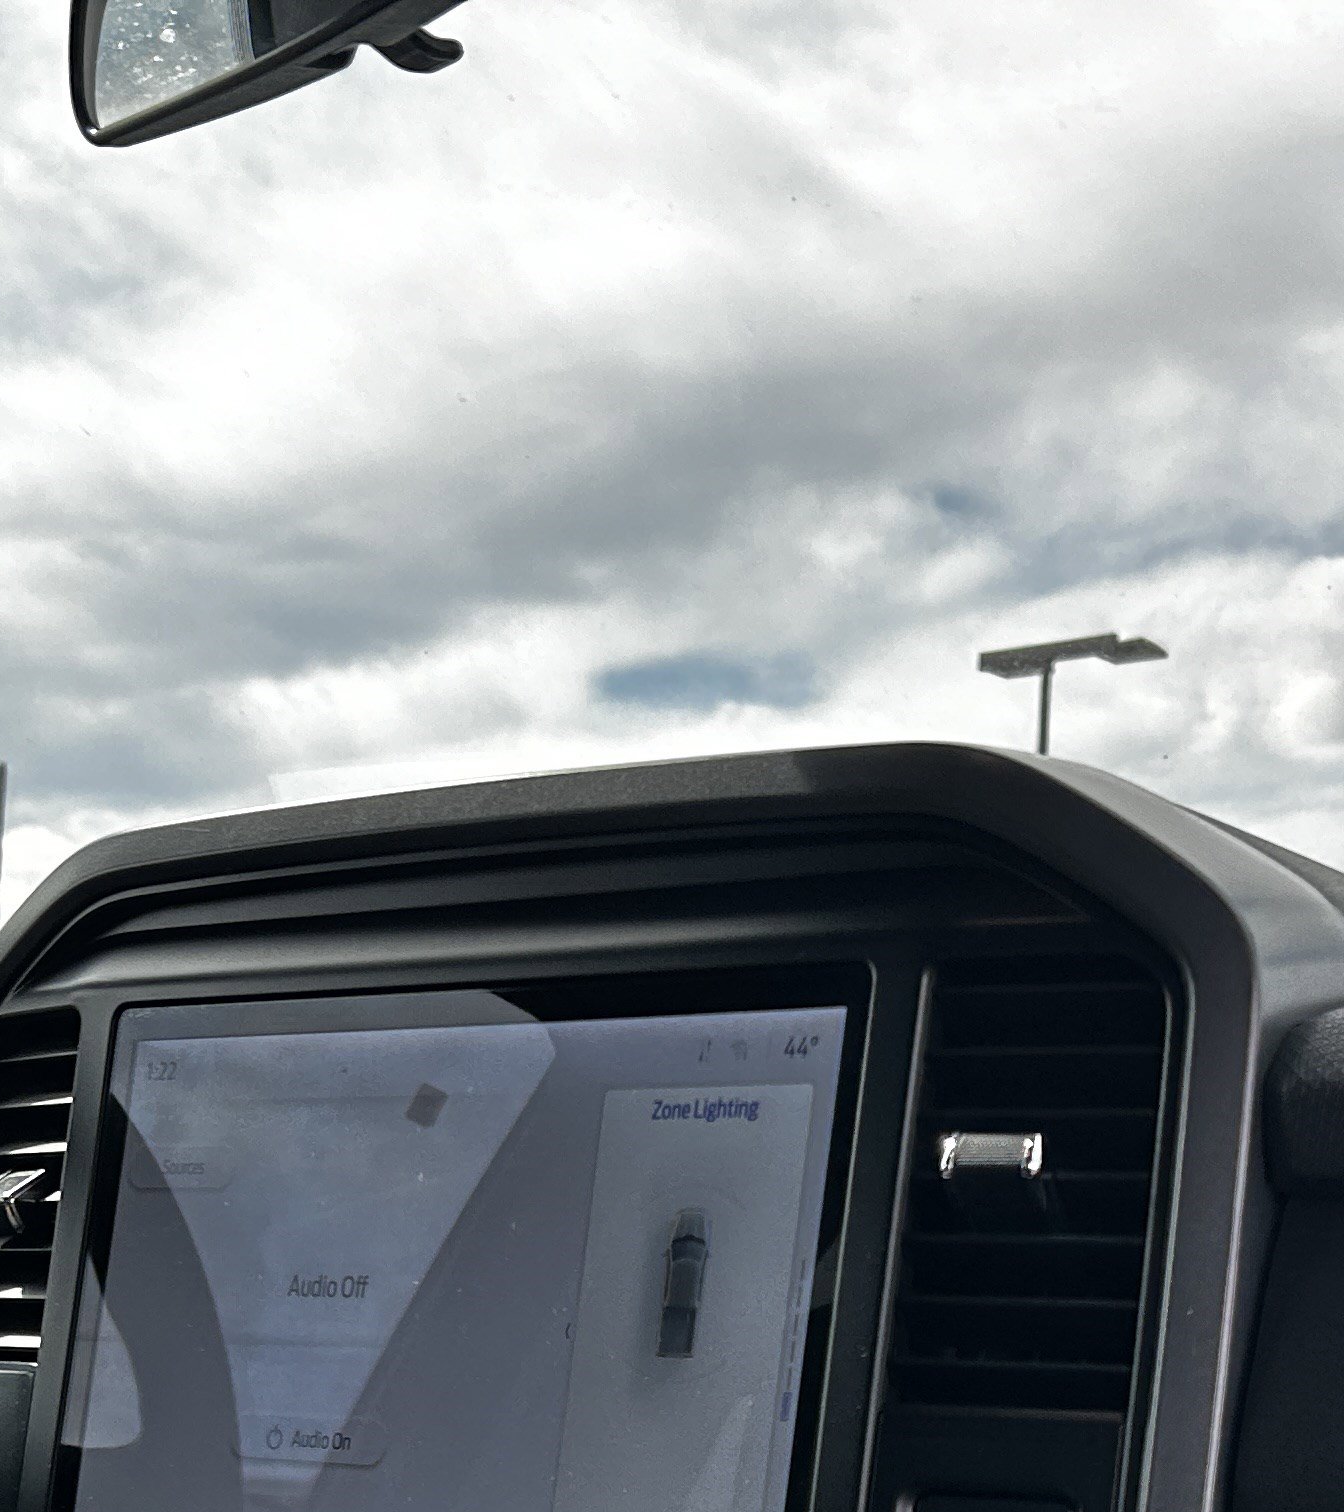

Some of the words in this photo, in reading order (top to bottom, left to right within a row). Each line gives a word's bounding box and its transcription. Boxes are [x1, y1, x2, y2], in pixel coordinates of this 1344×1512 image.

[651, 1099, 690, 1121] Zone
[692, 1098, 761, 1123] Lighting
[287, 1274, 338, 1298] Audio
[340, 1274, 369, 1298] Off
[291, 1428, 330, 1450] Audio
[331, 1432, 352, 1450] On
